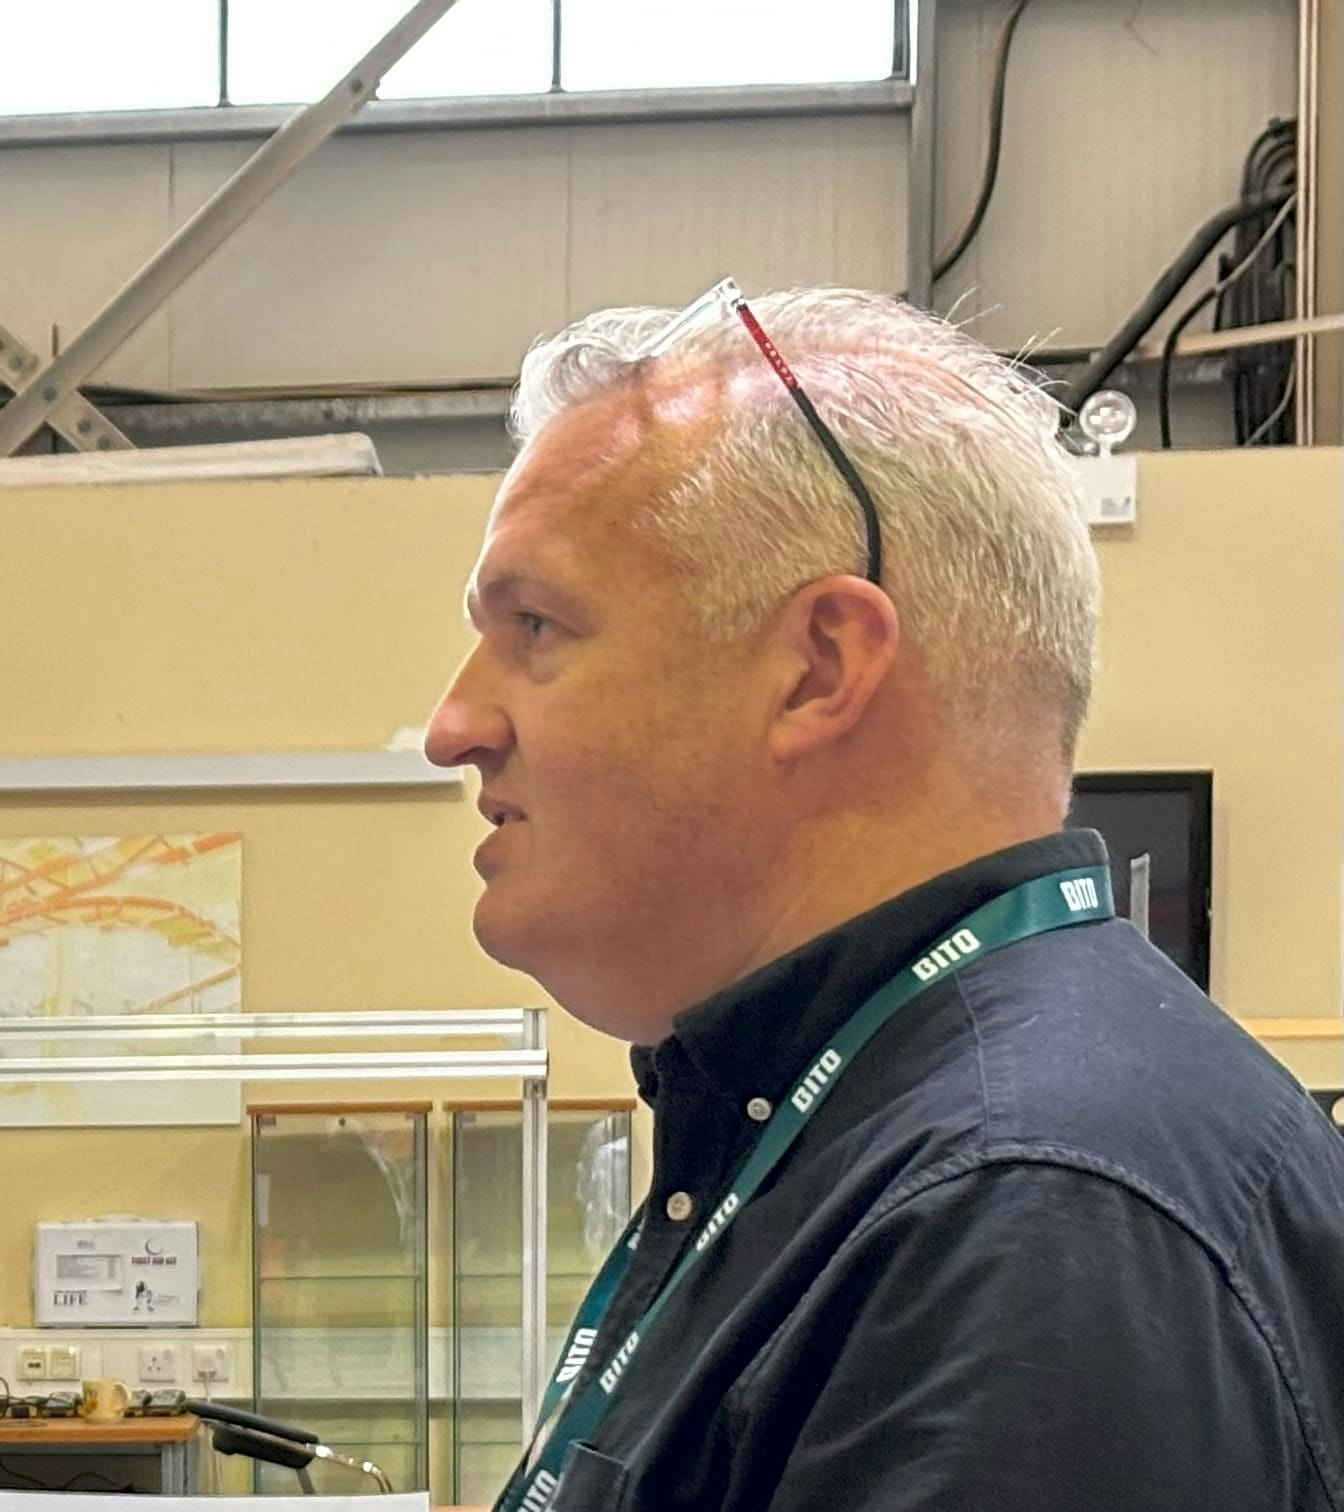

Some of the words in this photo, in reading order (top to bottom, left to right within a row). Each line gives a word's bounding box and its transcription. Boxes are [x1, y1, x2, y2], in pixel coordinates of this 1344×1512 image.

[1059, 877, 1099, 912] BITO
[911, 928, 982, 982] BITO
[791, 1048, 843, 1114] BITO
